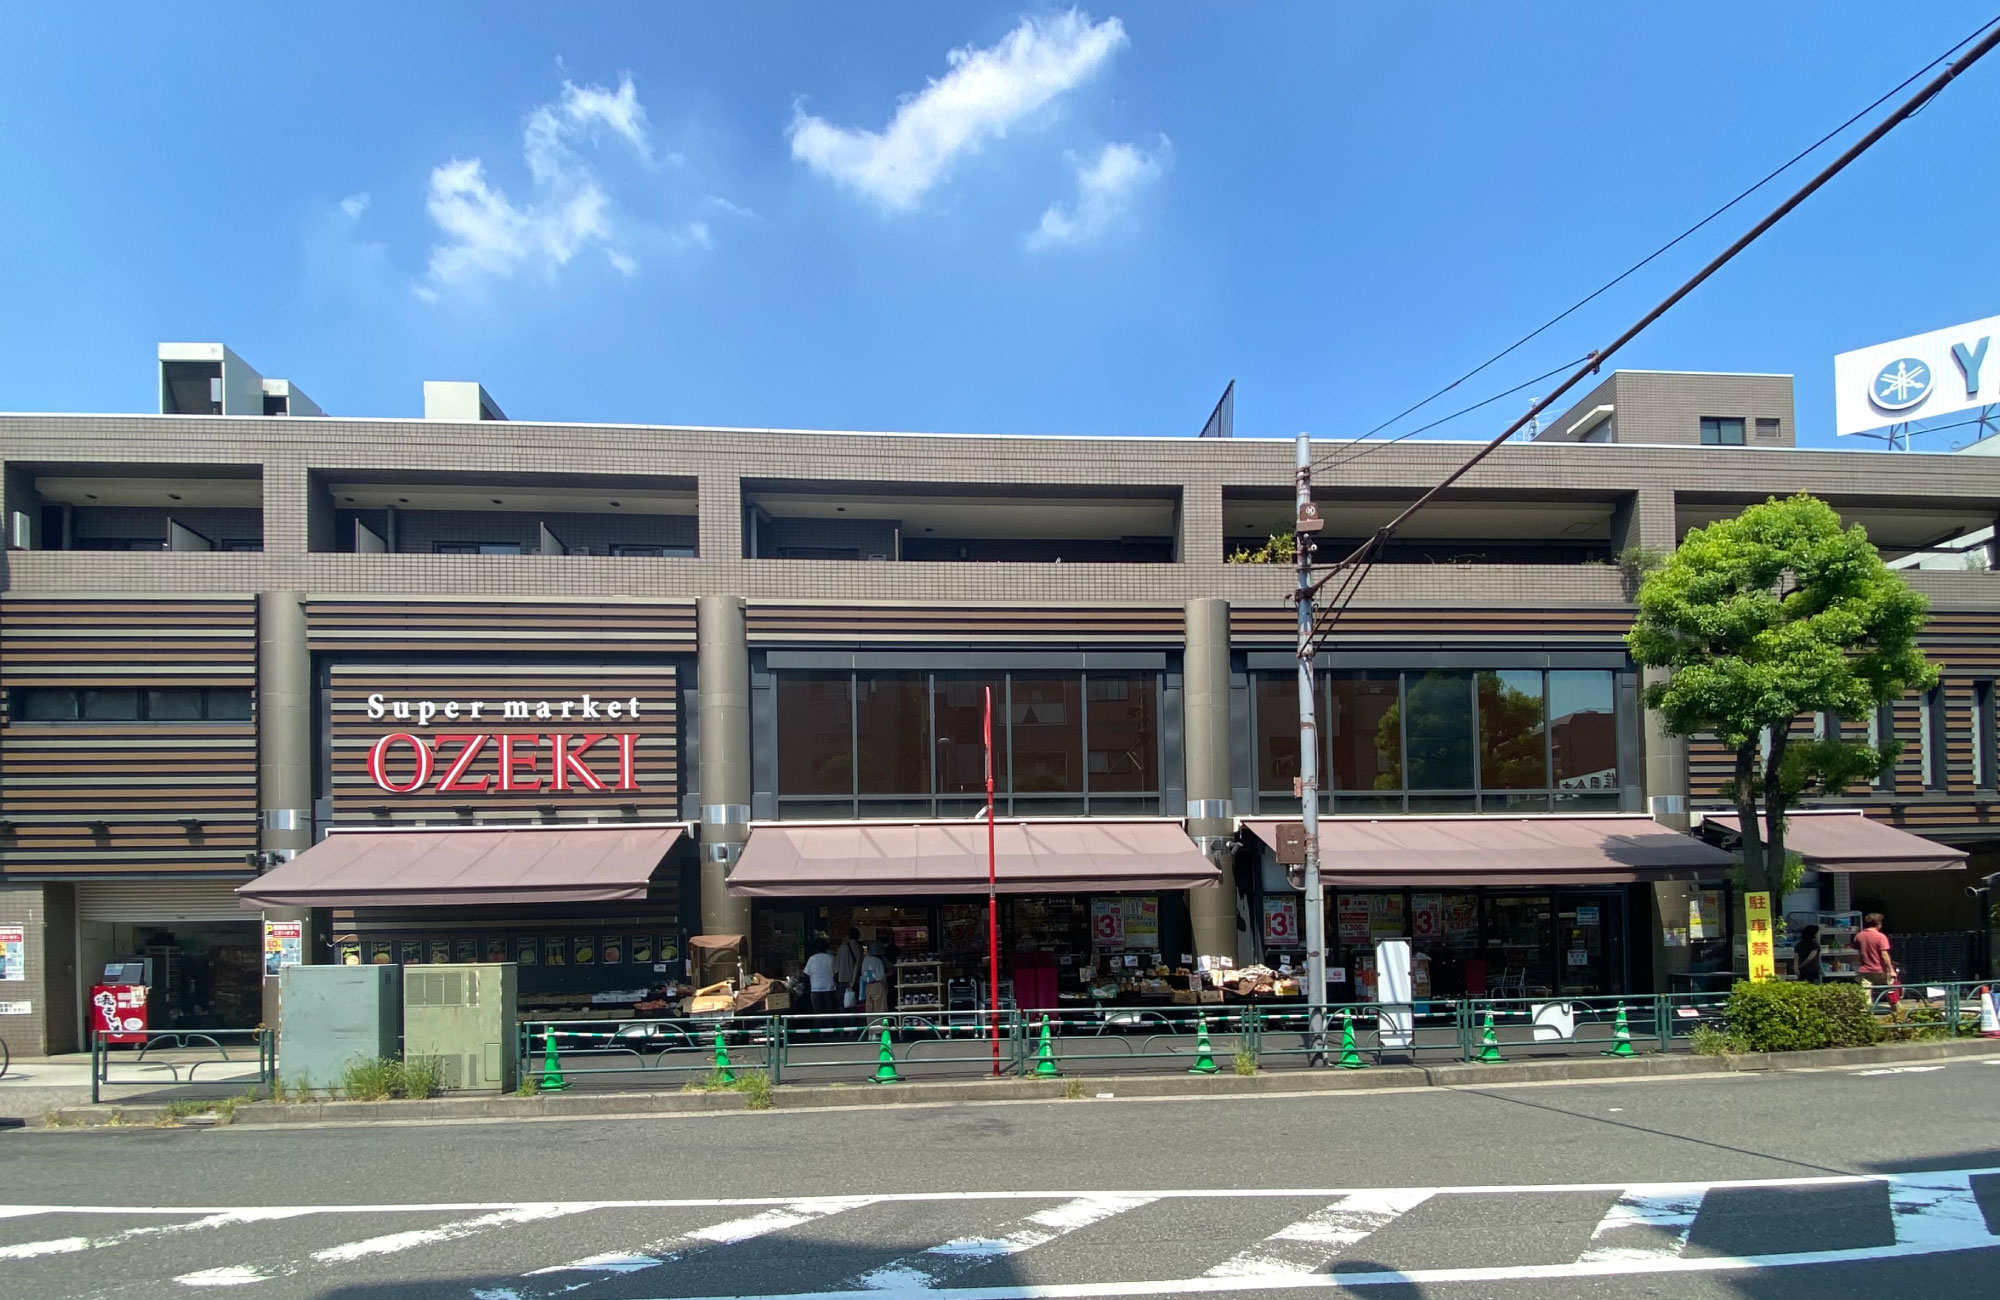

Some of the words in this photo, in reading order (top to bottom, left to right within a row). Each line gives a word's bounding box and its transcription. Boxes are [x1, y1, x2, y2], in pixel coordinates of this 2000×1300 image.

[1951, 336, 1990, 394] Y
[367, 693, 484, 725] Super
[503, 694, 640, 718] market
[366, 732, 640, 793] OZEKI
[1099, 914, 1116, 938] 3
[1271, 912, 1288, 936] 3
[1748, 895, 1769, 979] 駐車禁止
